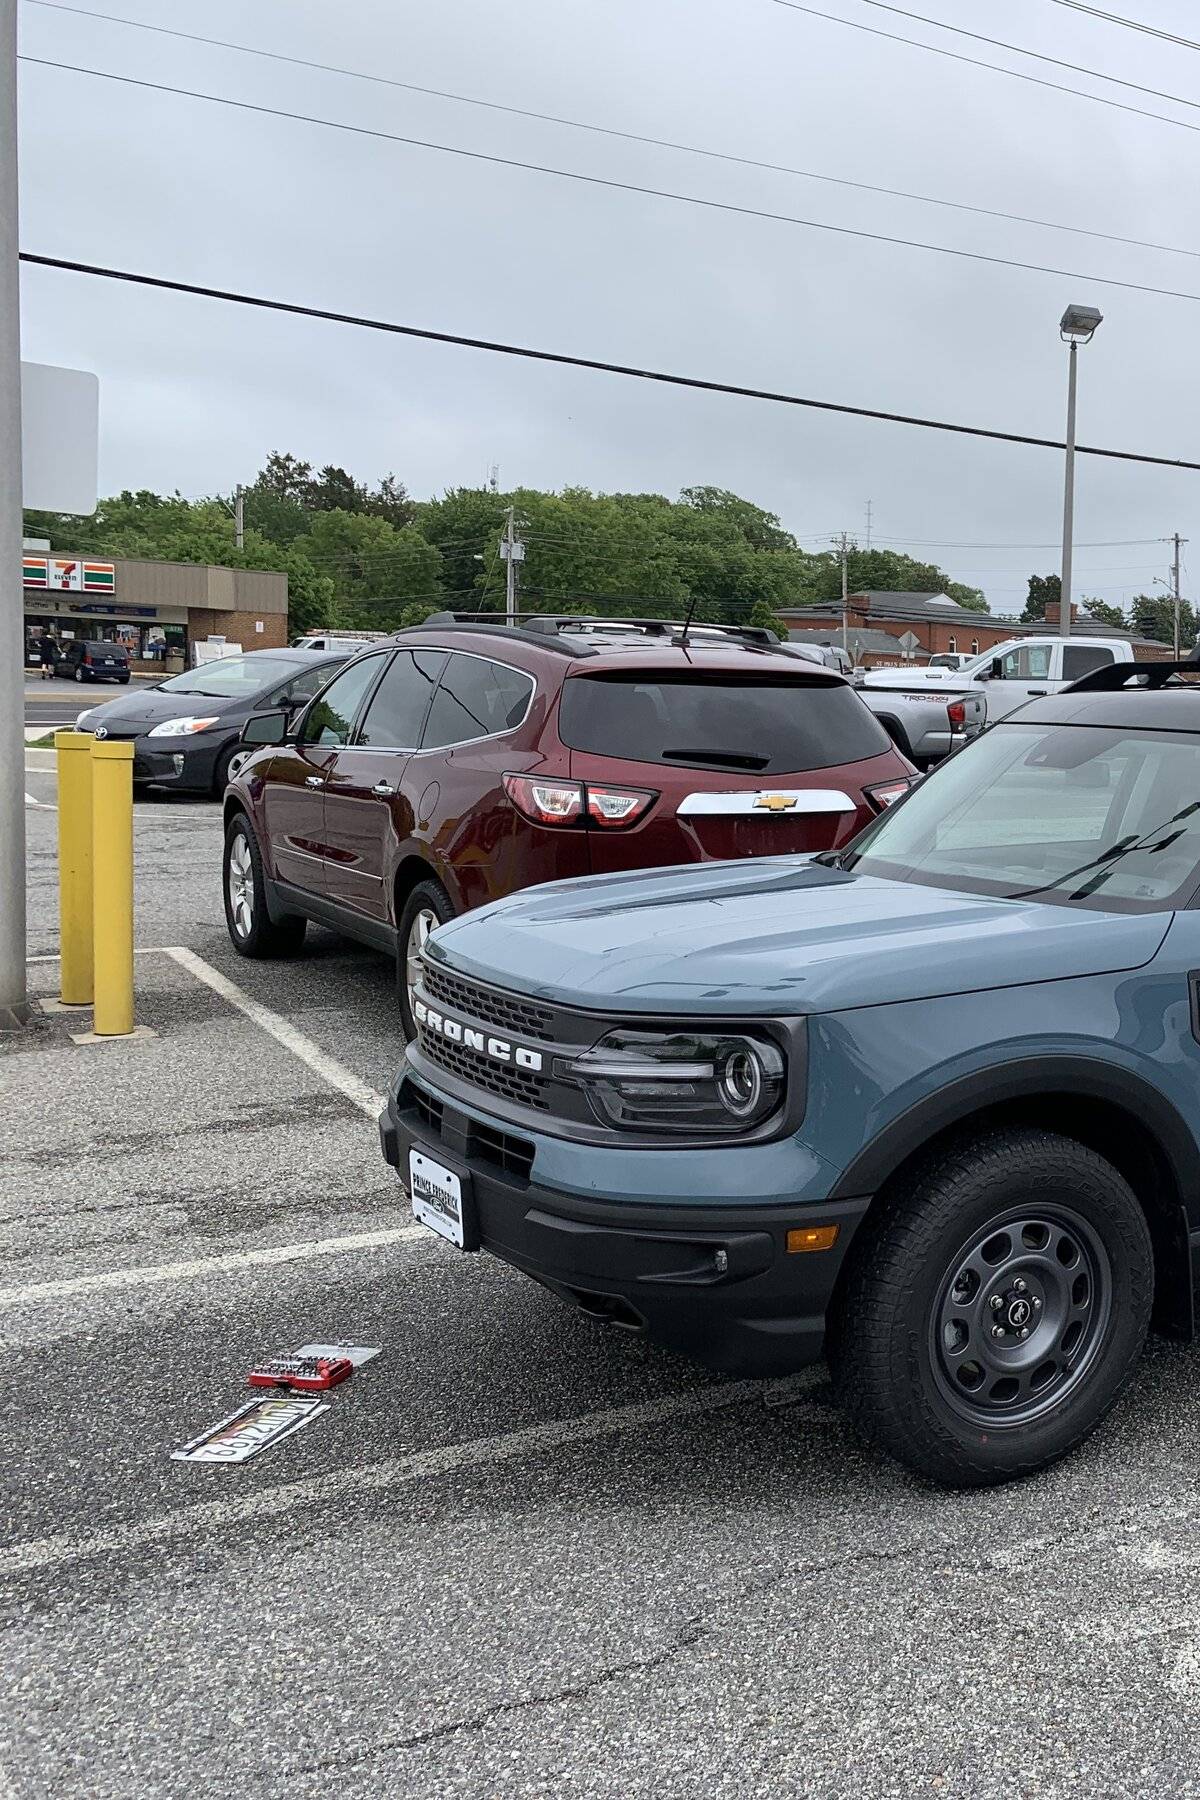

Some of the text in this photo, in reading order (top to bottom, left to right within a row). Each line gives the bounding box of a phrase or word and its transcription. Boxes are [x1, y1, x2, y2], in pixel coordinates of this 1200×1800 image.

[415, 1001, 542, 1071] BRONCO
[413, 1172, 459, 1212] PRINCE FREDERICK
